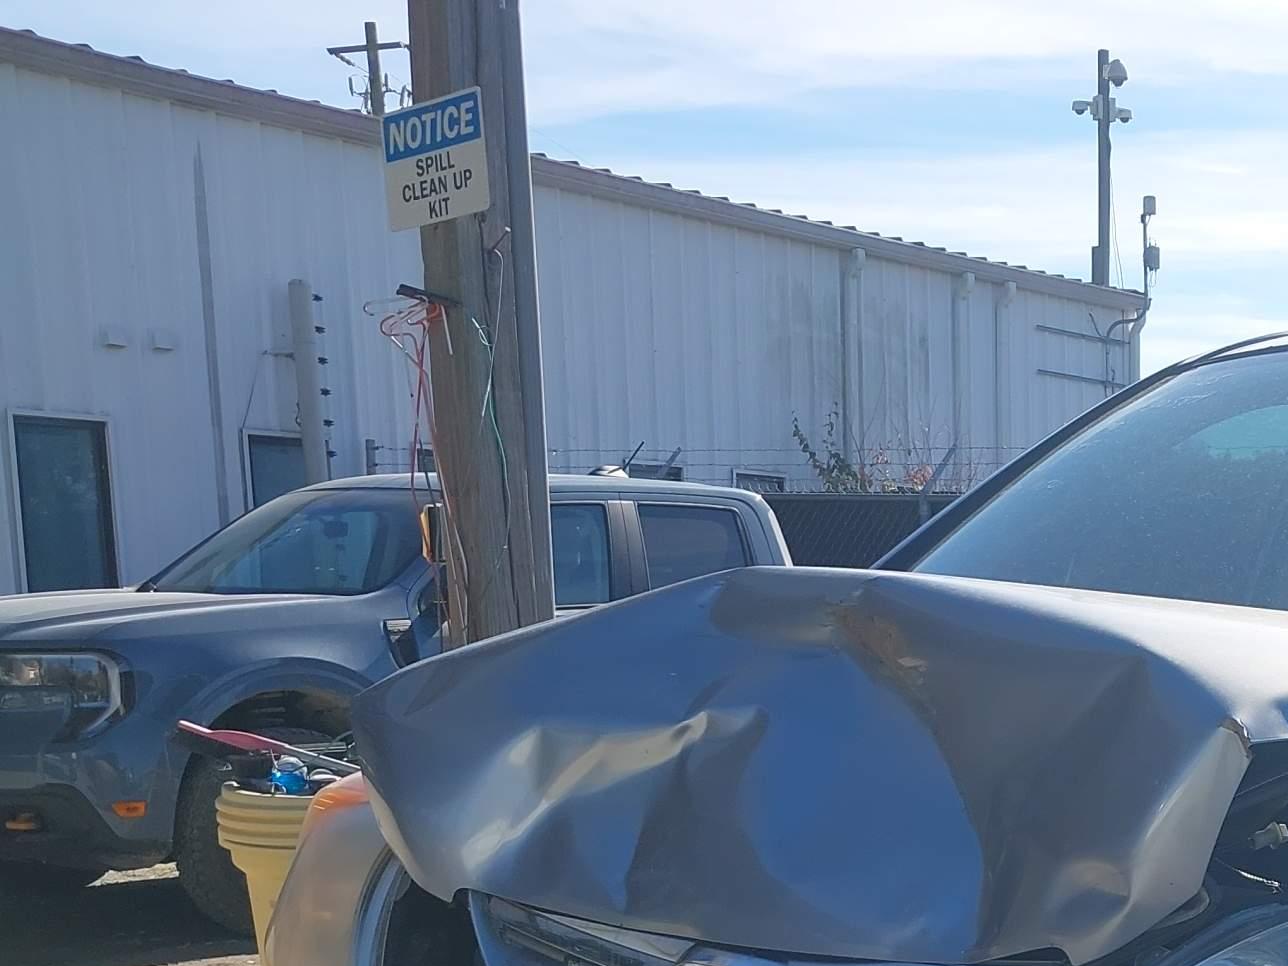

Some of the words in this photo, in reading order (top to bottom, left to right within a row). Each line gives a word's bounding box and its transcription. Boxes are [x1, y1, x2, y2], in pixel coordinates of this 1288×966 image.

[388, 100, 475, 155] NOTICE
[416, 151, 455, 177] SPILL
[402, 175, 449, 202] CLEAN
[453, 168, 473, 190] UP
[428, 197, 450, 219] KIT
